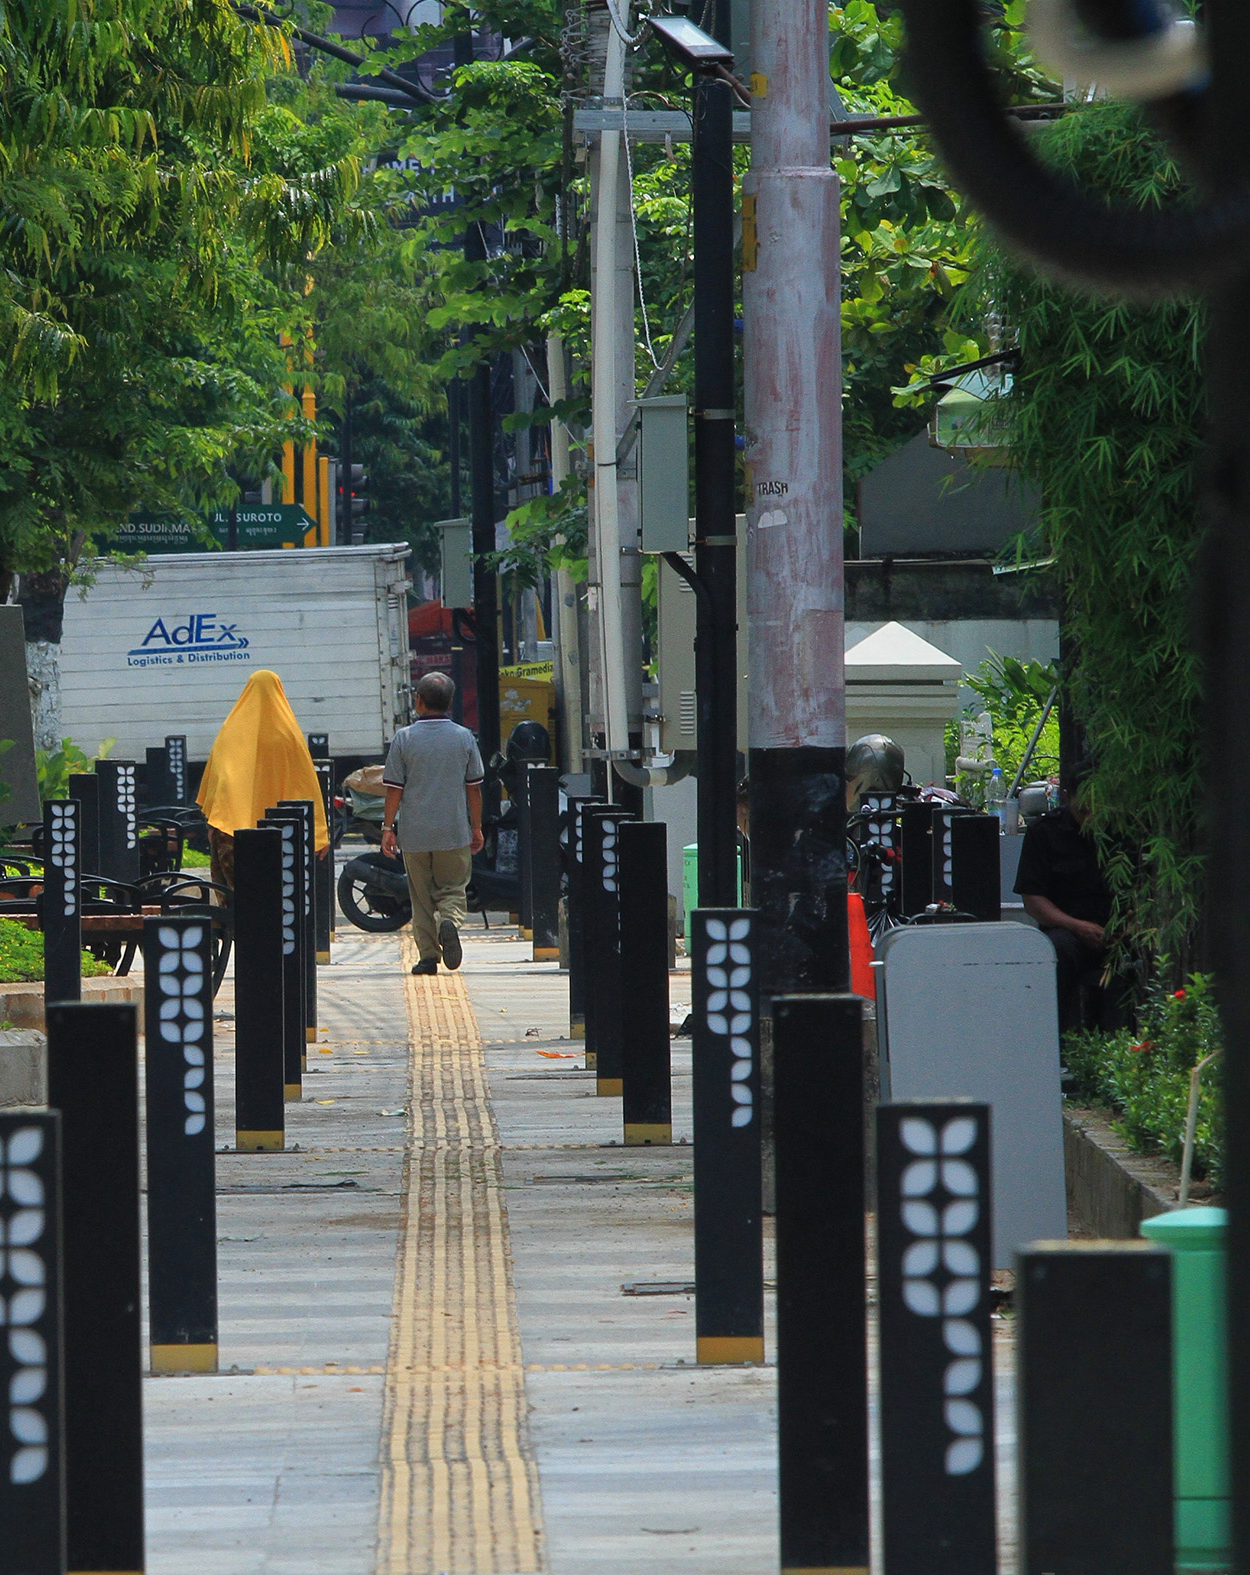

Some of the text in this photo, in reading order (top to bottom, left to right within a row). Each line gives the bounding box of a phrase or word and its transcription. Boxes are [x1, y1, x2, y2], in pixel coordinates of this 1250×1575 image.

[758, 481, 788, 495] TRASH
[236, 512, 282, 522] SUROTO
[117, 523, 196, 533] ND.SUDIMA
[141, 614, 237, 646] AdEx
[127, 650, 250, 667] Logistics & Distribution
